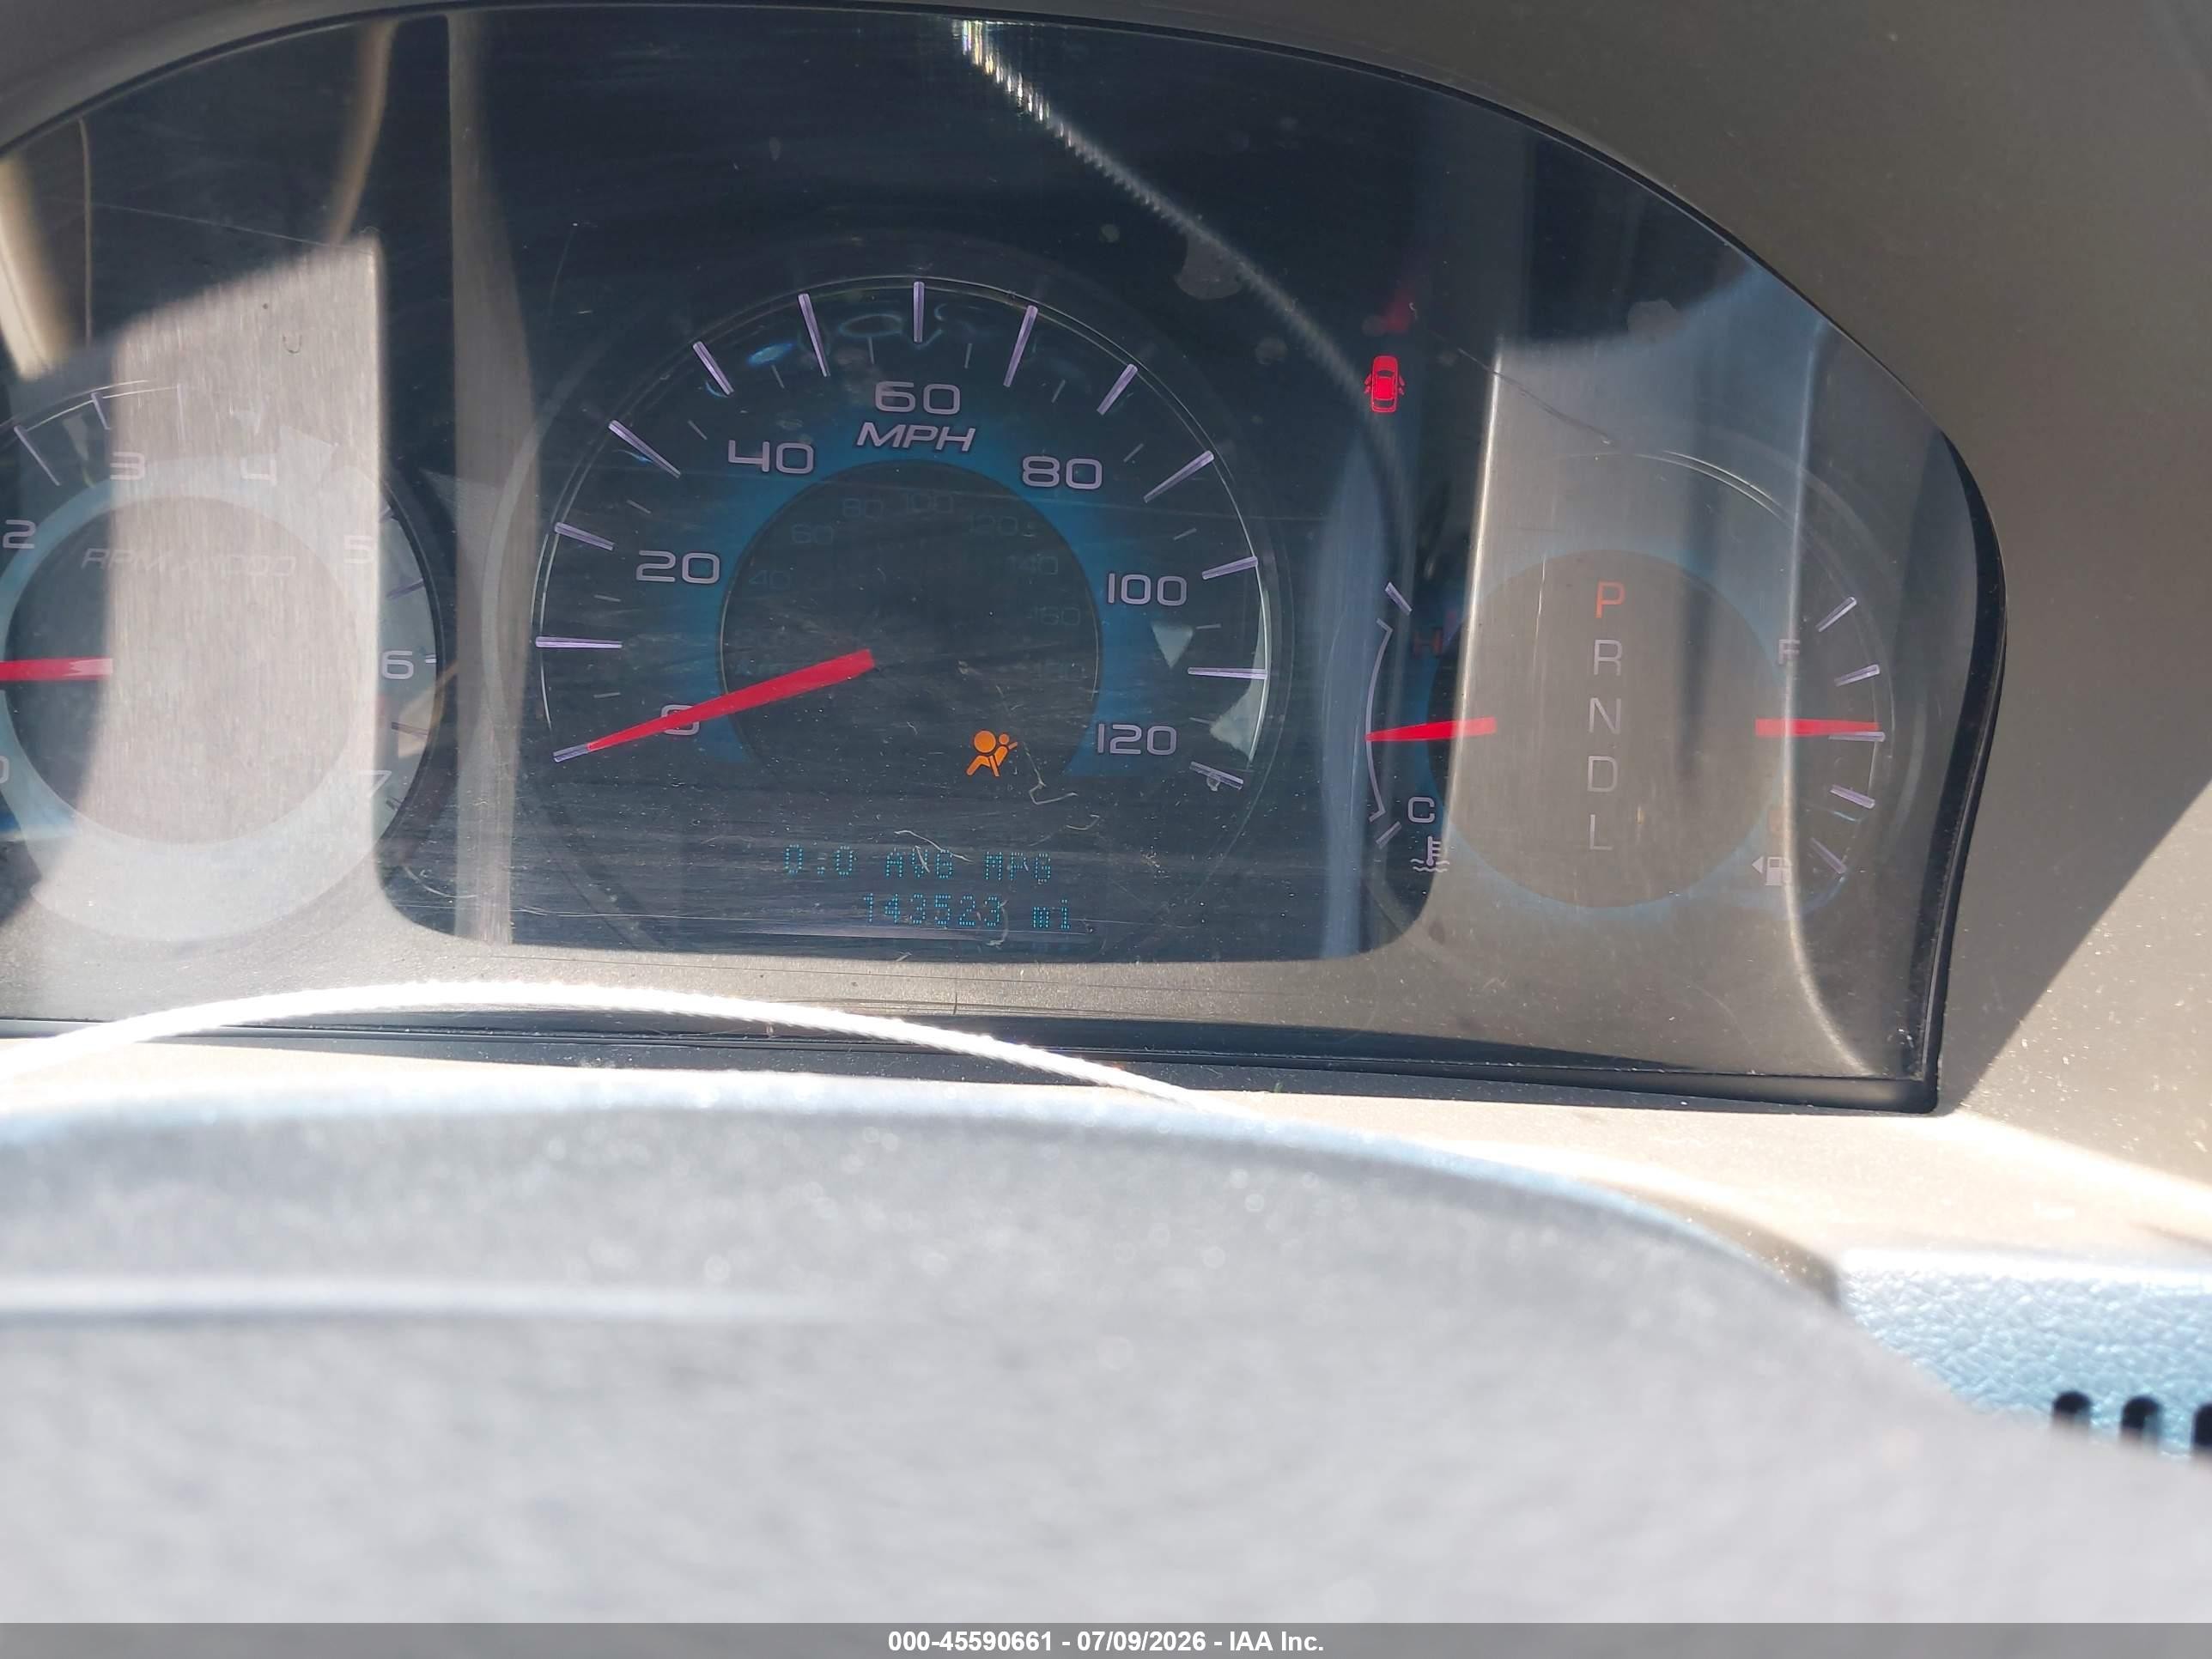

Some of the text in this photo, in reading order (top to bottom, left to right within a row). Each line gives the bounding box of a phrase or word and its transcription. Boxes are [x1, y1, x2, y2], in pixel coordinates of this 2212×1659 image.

[874, 380, 961, 416] 60
[857, 422, 975, 452] MPH
[110, 452, 145, 481] 3
[240, 458, 278, 487] 4
[727, 440, 814, 475] 40
[1022, 456, 1103, 490] 80
[3, 520, 36, 549] 2
[343, 536, 374, 564] 5
[636, 550, 720, 585] 20
[1107, 573, 1188, 606] 100
[1595, 581, 1626, 618] P
[381, 651, 414, 680] 6
[1594, 639, 1624, 676] R
[1778, 638, 1800, 665] F
[660, 704, 700, 736] 0
[1589, 697, 1620, 735] N
[1097, 723, 1177, 756] 120
[1587, 755, 1618, 793] D
[1408, 796, 1435, 823] C
[1590, 814, 1613, 851] L
[886, 848, 954, 879] AVG
[985, 851, 1051, 884] MPG
[863, 892, 1071, 929] 143523 mi
